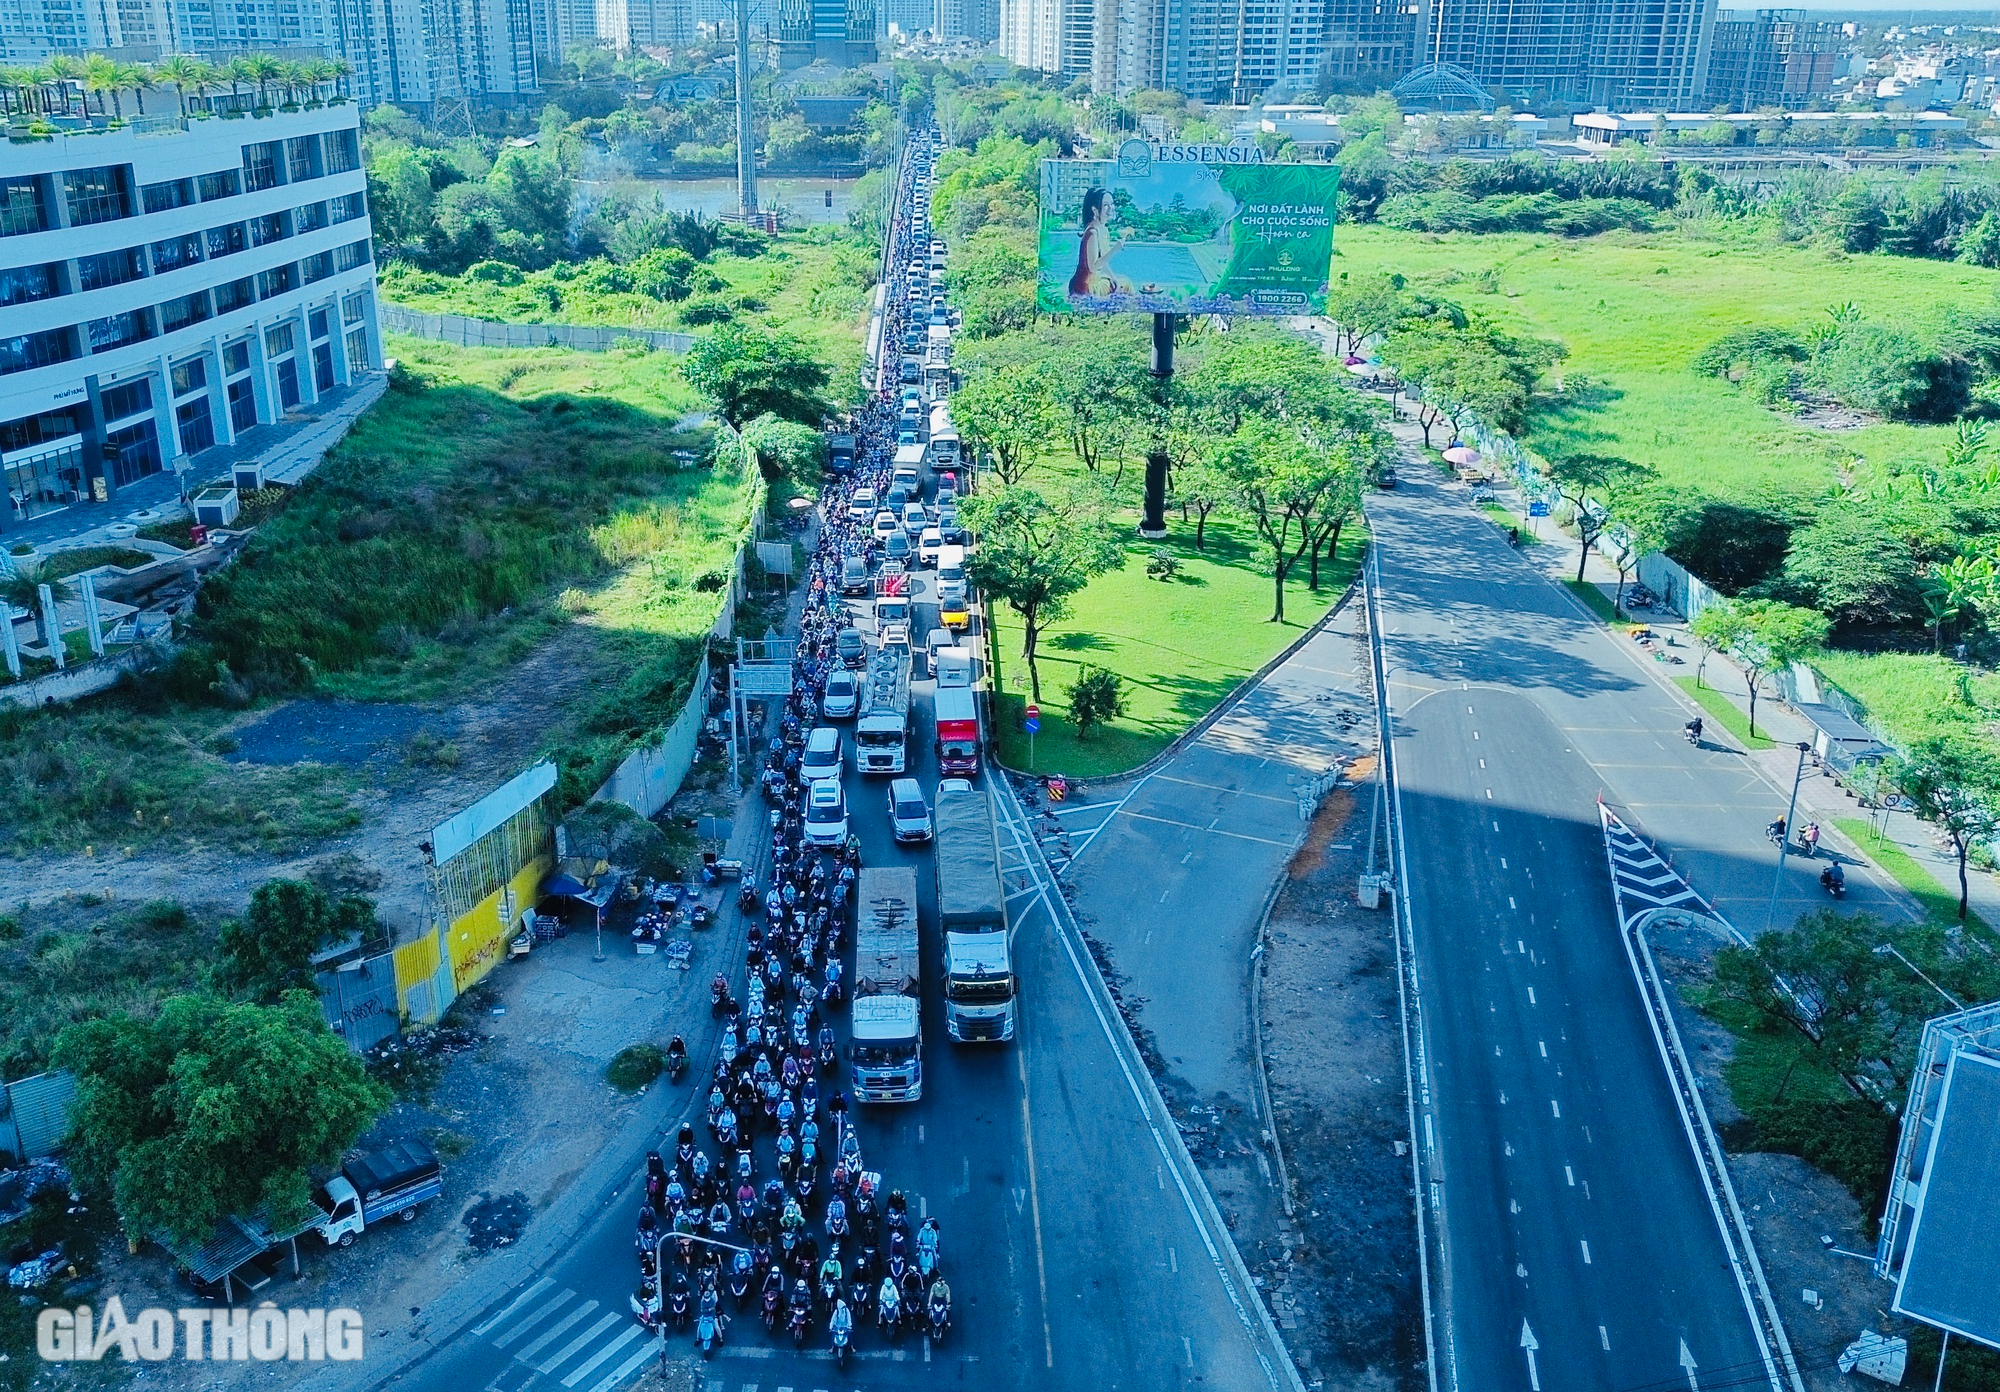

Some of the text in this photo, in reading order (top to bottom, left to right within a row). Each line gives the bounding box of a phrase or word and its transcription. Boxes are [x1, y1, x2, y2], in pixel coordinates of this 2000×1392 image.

[1158, 146, 1264, 163] ESSENSIA
[1196, 169, 1223, 180] SKY
[1249, 203, 1324, 214] NƠI ĐẤT LÀNH
[1241, 215, 1330, 227] CHO CUỘC SỐNG
